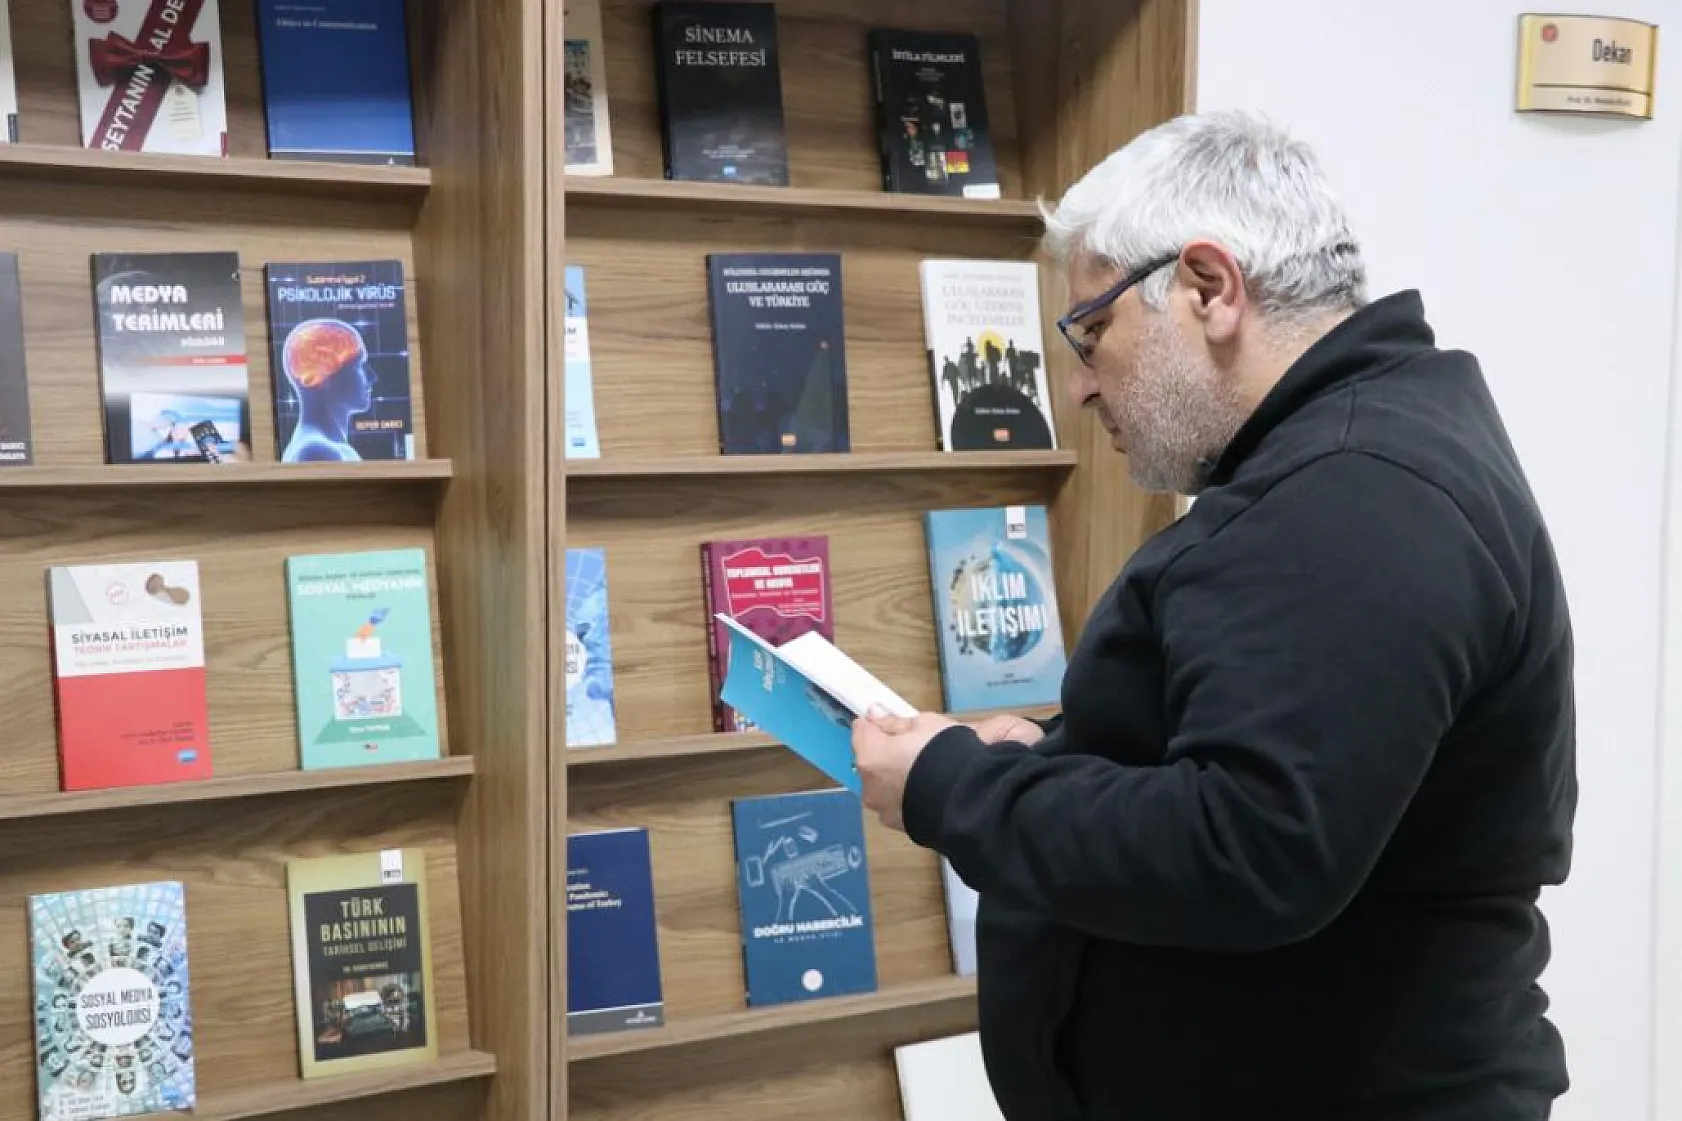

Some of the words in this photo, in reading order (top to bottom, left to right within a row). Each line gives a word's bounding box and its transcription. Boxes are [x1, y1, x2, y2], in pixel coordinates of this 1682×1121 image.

[685, 23, 755, 44] SİNEMA
[674, 48, 766, 67] FELSEFESİ
[1592, 38, 1632, 64] Dekan
[110, 284, 188, 304] MEDYA
[112, 306, 225, 332] TERİMLERİ
[71, 630, 128, 645] SİYASAL
[131, 624, 188, 642] İLETİŞİM
[339, 896, 384, 919] TÜRK
[320, 914, 407, 943] BASINININ
[81, 990, 117, 1009] SOSYAL
